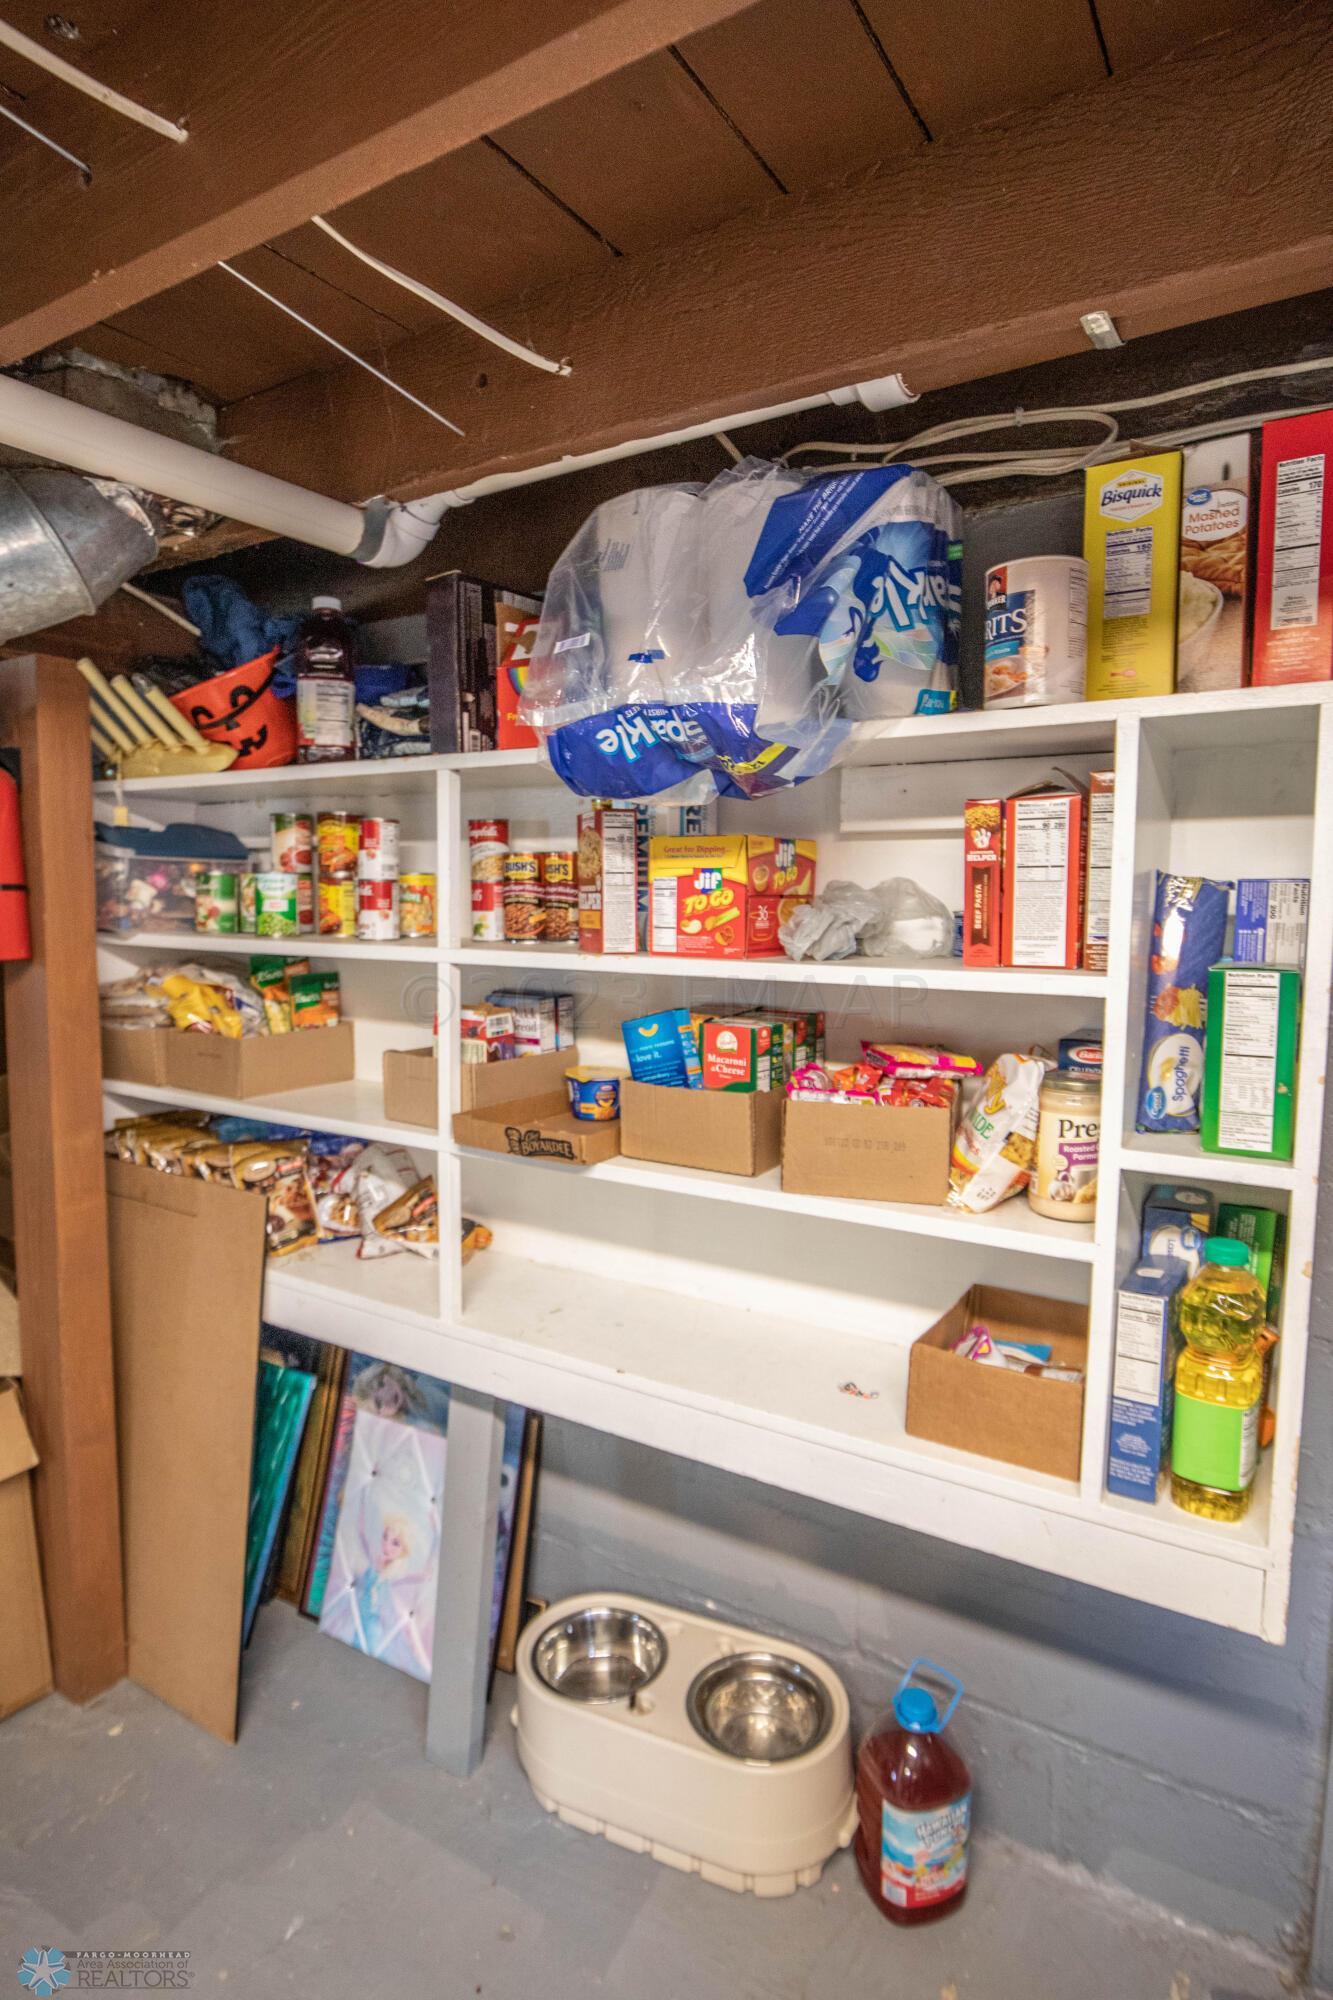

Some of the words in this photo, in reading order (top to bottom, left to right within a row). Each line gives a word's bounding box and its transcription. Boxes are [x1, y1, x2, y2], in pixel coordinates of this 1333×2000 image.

[1101, 484, 1162, 507] Bisquick
[1189, 508, 1240, 523] Mashed
[1185, 519, 1240, 535] Potatoes
[985, 608, 1027, 640] RITS
[684, 895, 707, 914] TO
[710, 889, 734, 907] GO
[707, 1053, 747, 1067] Macaroni
[716, 1064, 746, 1076] Cheese
[1172, 1045, 1191, 1102] Spaghetti
[1059, 1119, 1100, 1139] Pre
